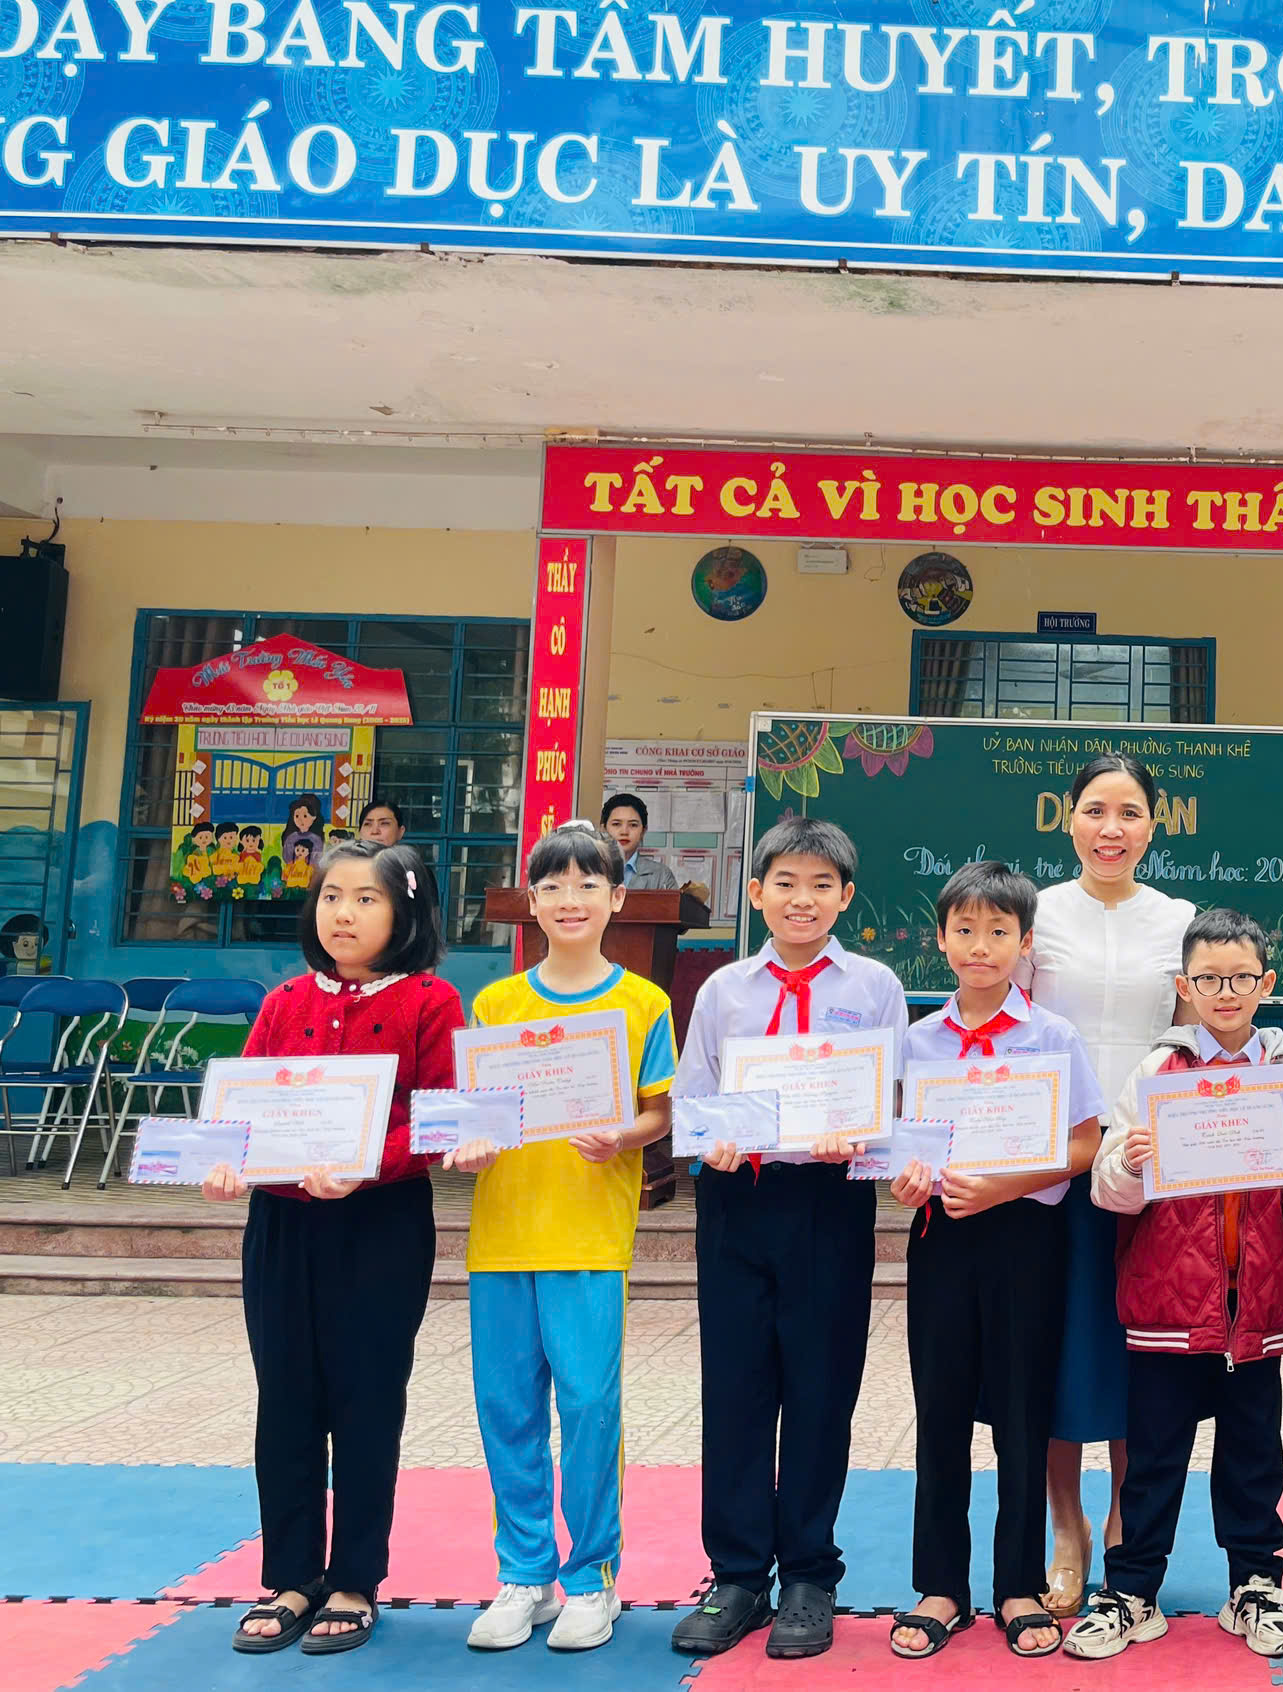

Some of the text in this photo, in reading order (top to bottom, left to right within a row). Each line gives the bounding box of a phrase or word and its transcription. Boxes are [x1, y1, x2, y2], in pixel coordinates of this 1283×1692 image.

[515, 0, 731, 84] TÂM
[760, 0, 1115, 117] HUYẾT,
[106, 101, 357, 196] GIÁO
[386, 129, 598, 218] DỤC
[631, 120, 758, 211] LÀ
[794, 146, 927, 218] UY
[957, 133, 1145, 244] TÍN,
[584, 456, 703, 516] TẤT
[719, 462, 801, 520] CẢ
[817, 469, 881, 521] VÌ
[897, 482, 1017, 535] HỌC
[1033, 486, 1171, 529] SINH
[550, 616, 566, 656] CÔ
[1044, 616, 1058, 629] HỘI
[538, 687, 571, 727] HẠNH
[535, 742, 567, 782] PHÚC
[635, 745, 662, 756] CÔNG
[665, 747, 688, 757] KHAI
[691, 747, 704, 757] CƠ
[992, 756, 1043, 775] TRƯỜNG
[1047, 755, 1075, 776] TIỂU
[1168, 764, 1205, 779] SUNG
[1006, 738, 1034, 752] BAN
[1085, 738, 1112, 753] DÂN
[1120, 736, 1172, 756] PHƯỜNG
[1176, 741, 1222, 756] THANH
[1226, 740, 1252, 758] KHÊ
[1134, 849, 1206, 881] Năm
